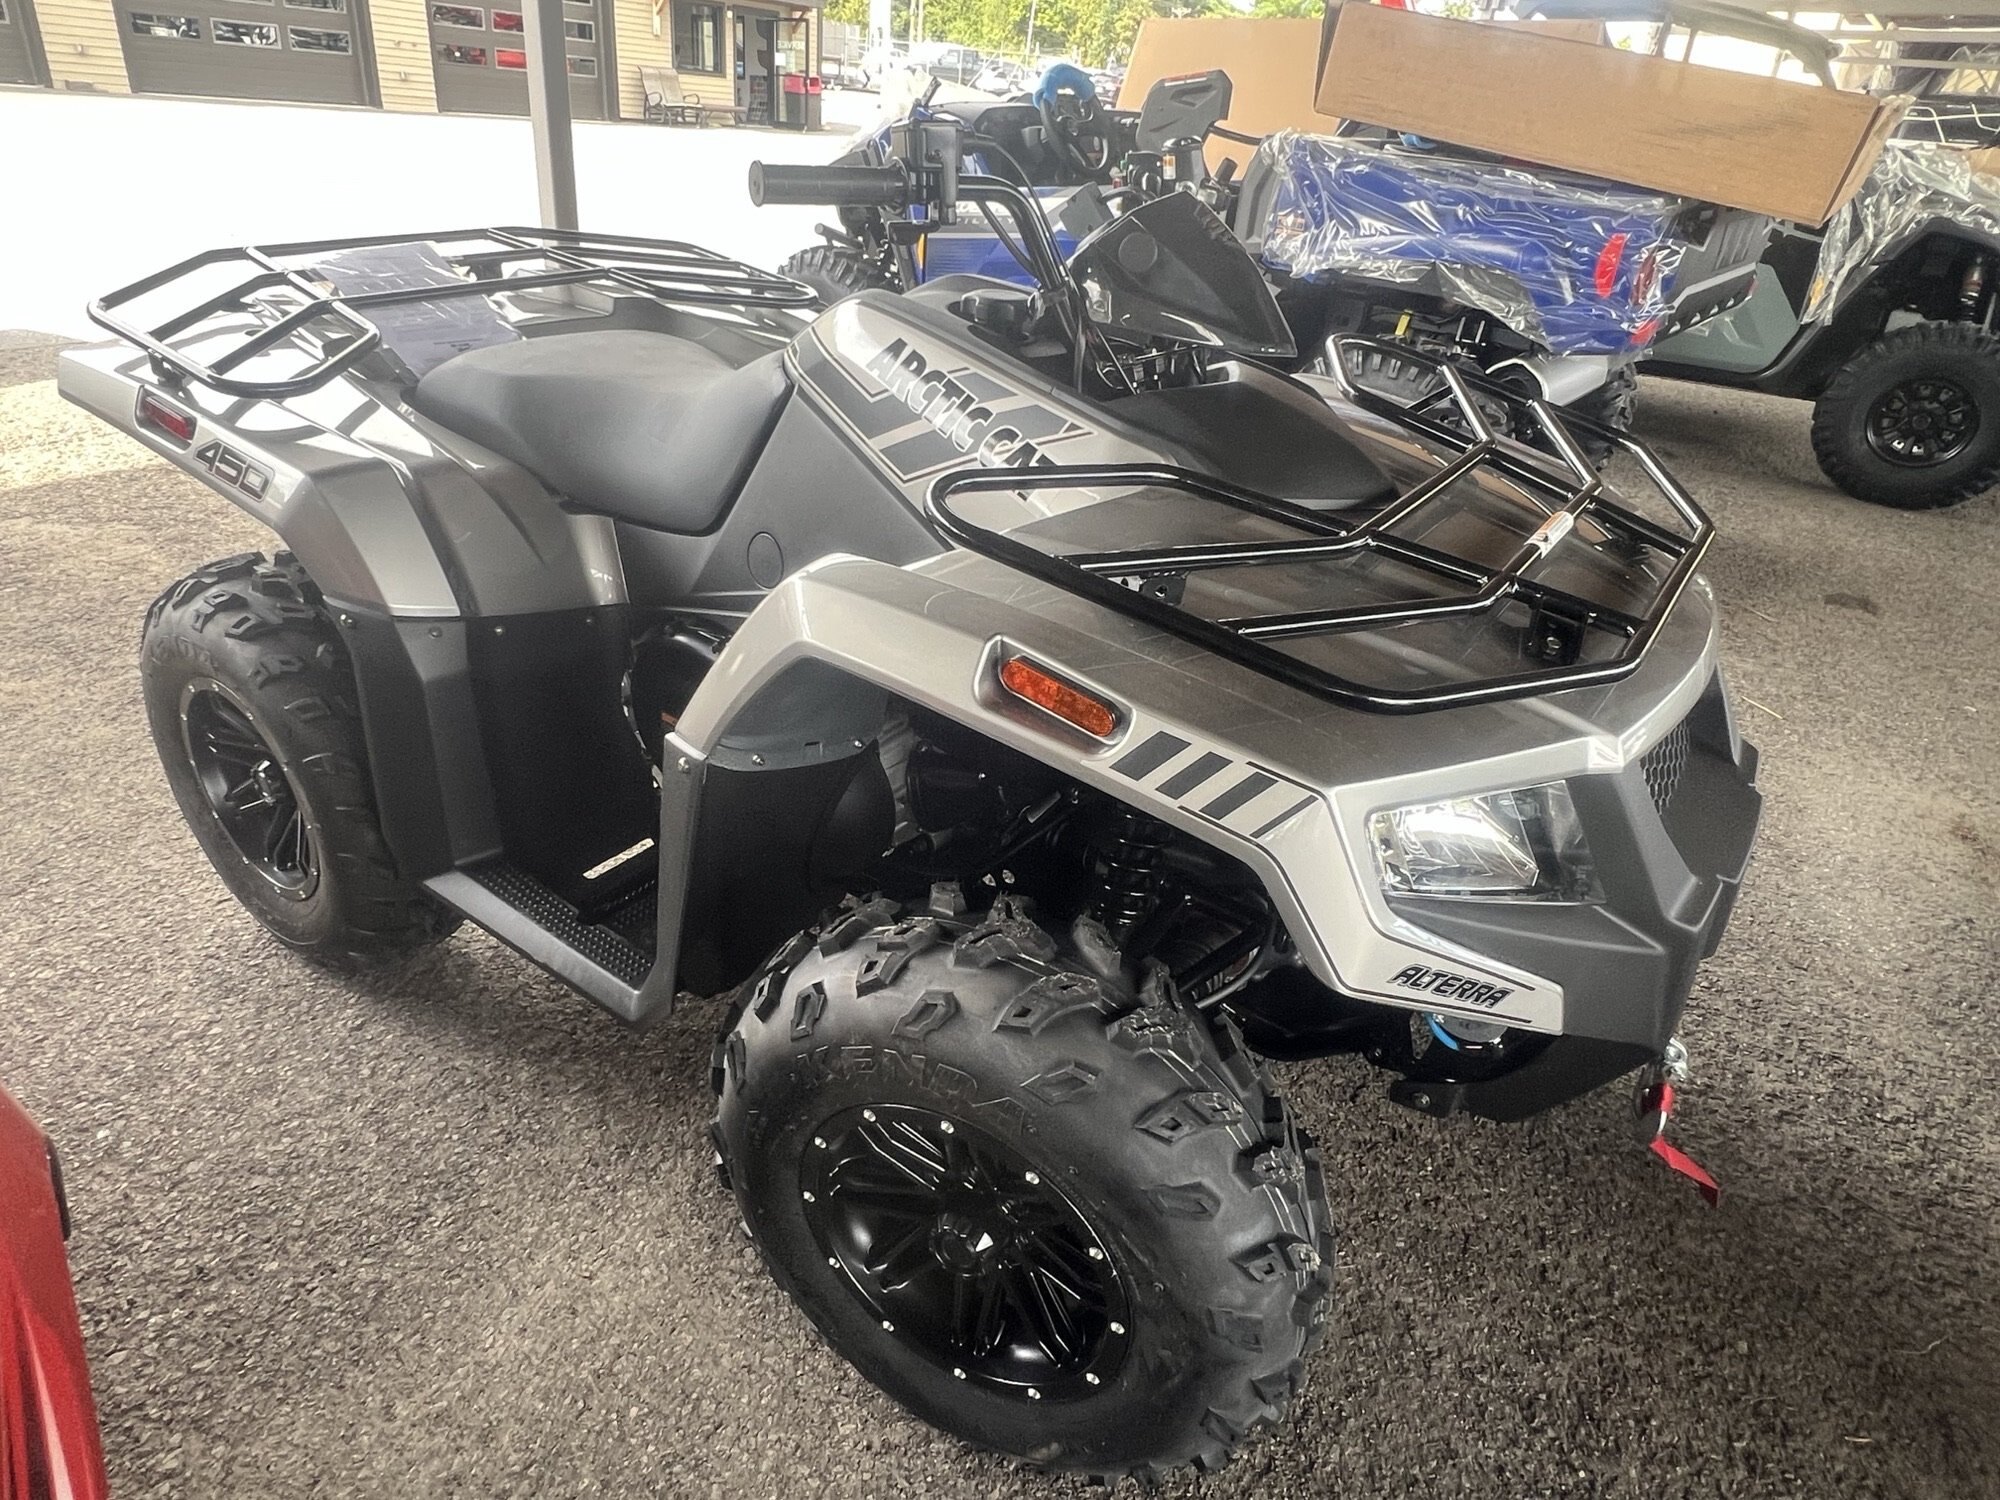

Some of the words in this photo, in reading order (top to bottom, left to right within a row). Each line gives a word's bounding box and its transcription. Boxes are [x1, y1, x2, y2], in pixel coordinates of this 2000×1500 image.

[866, 336, 996, 453] ARCTIC
[194, 439, 274, 502] 450
[1387, 964, 1515, 1009] ALTERRA
[796, 1045, 1026, 1136] KENDA
